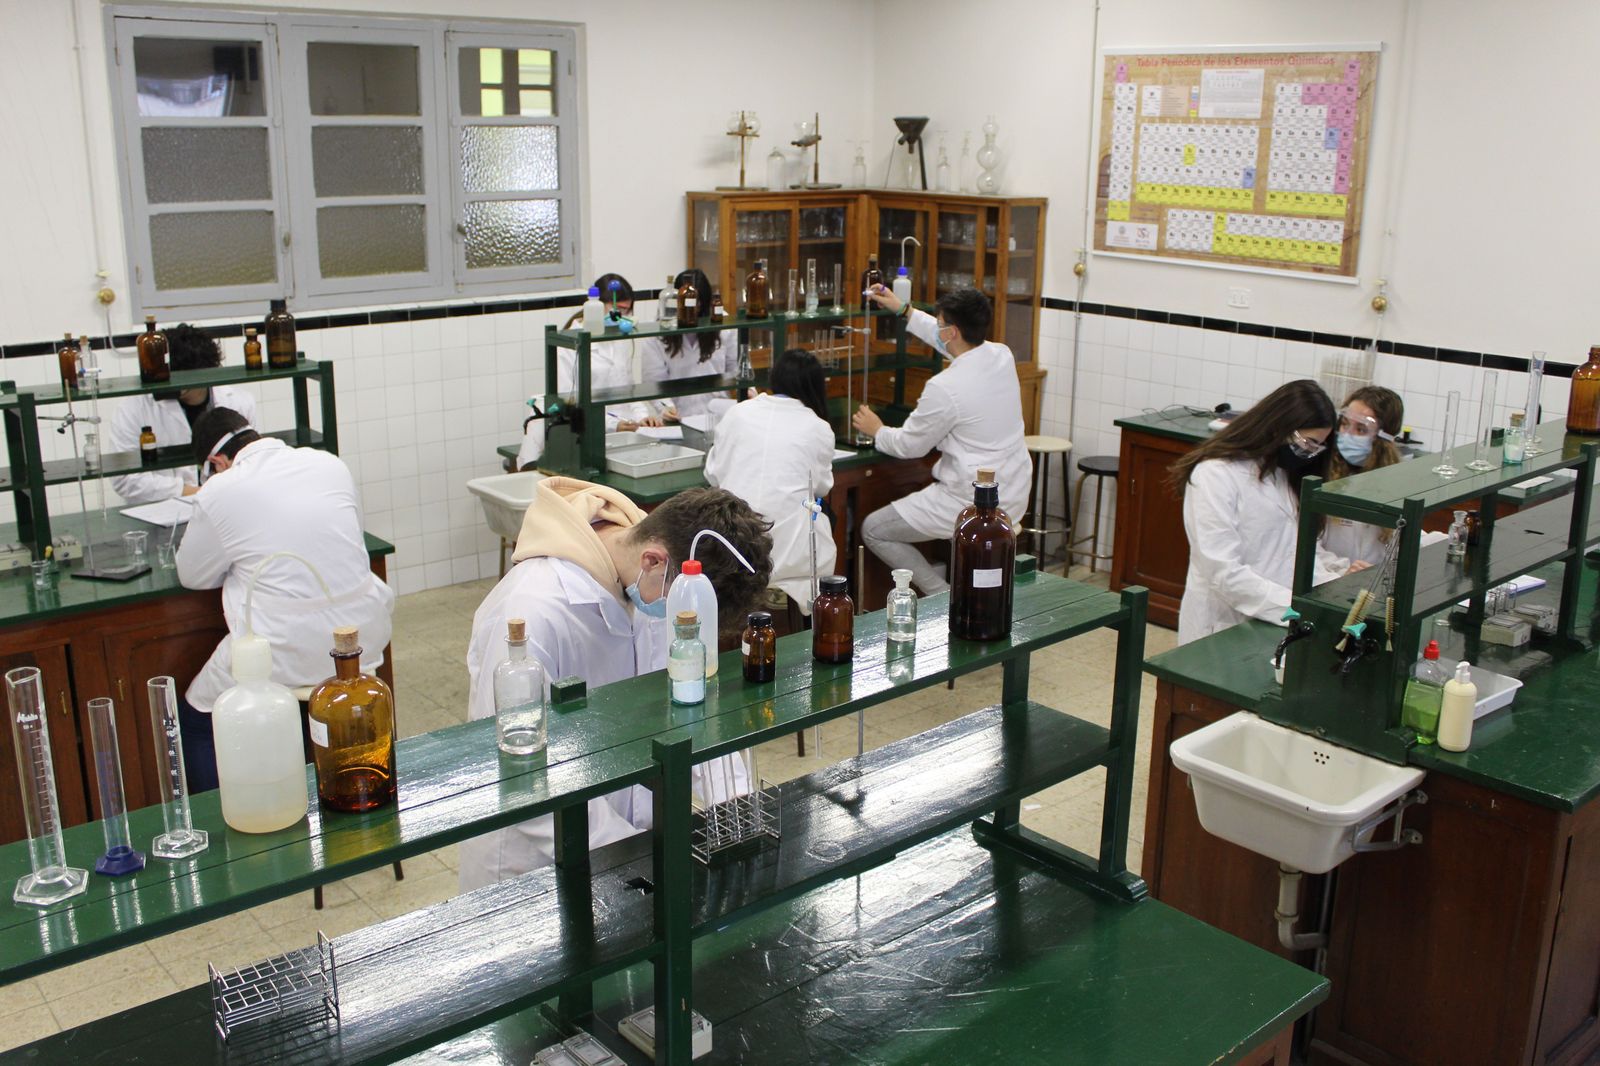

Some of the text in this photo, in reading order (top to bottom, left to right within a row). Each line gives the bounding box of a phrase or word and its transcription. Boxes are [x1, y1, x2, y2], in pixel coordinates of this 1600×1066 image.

[1137, 57, 1158, 67] Tabla
[1204, 56, 1215, 65] de
[1218, 56, 1231, 65] los
[1234, 55, 1285, 66] Elementos
